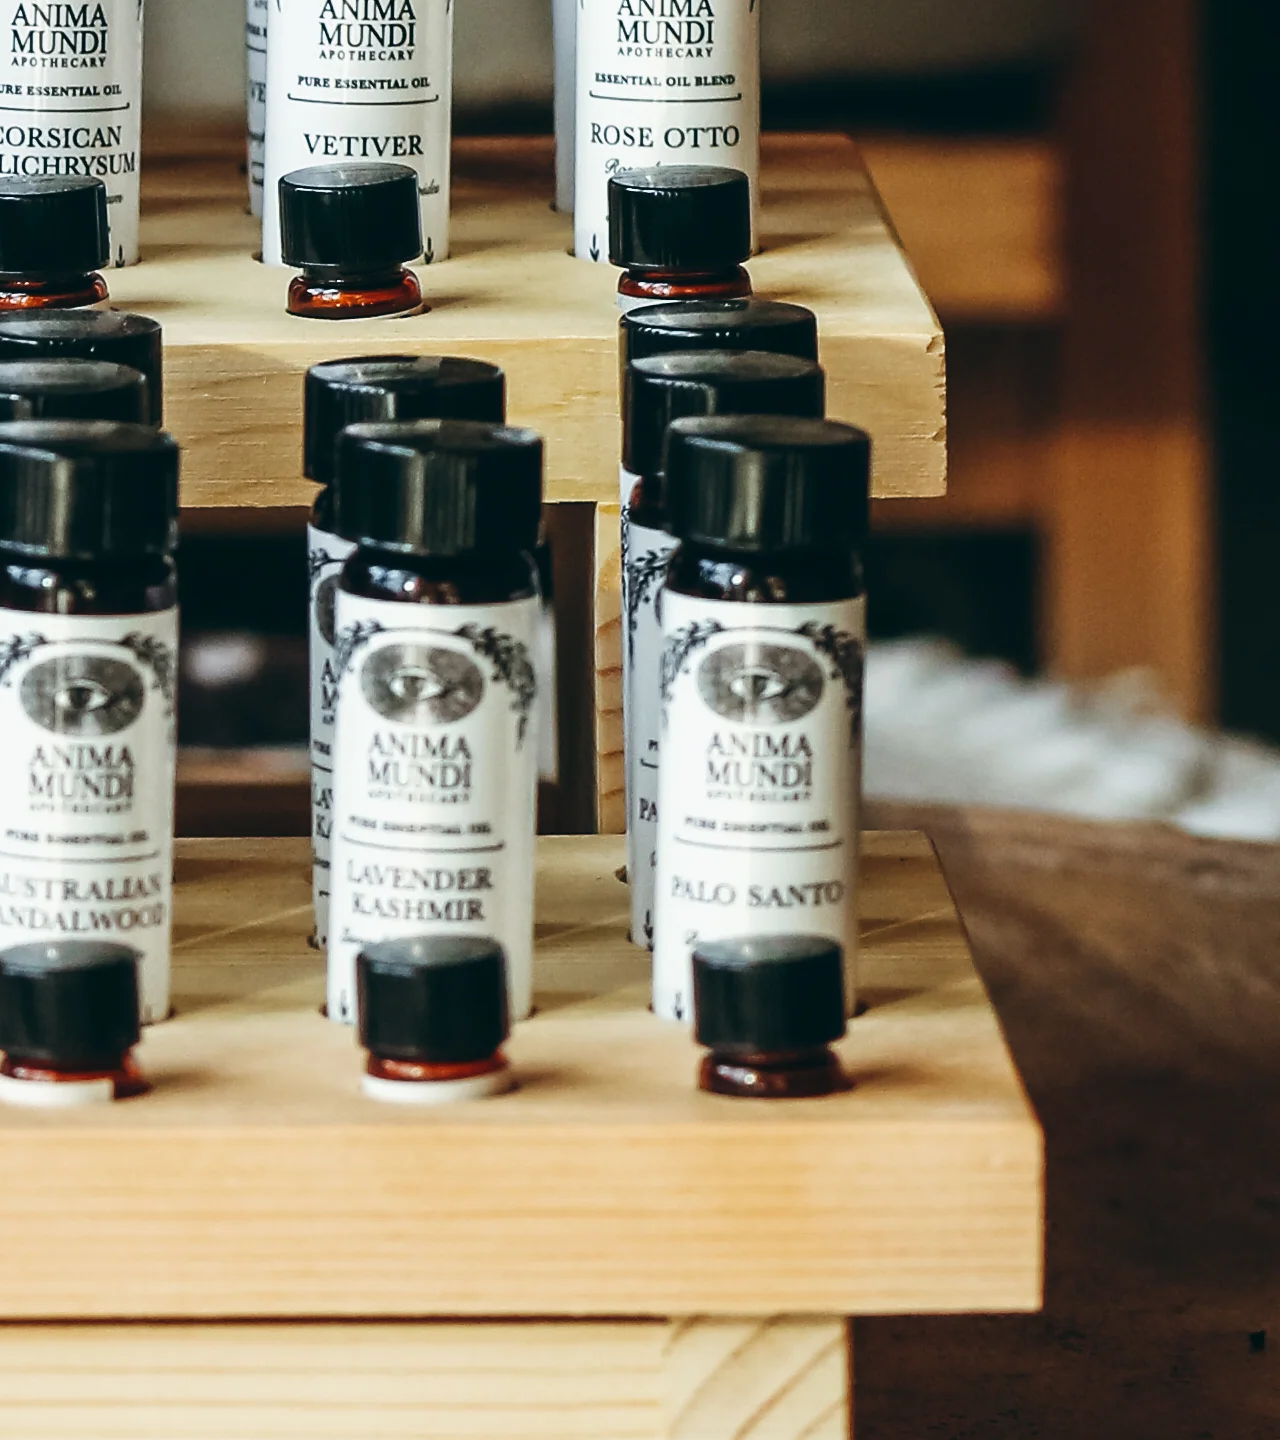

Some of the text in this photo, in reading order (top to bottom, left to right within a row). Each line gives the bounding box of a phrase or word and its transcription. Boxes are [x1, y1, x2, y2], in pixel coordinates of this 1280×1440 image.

[11, 3, 108, 27] ANIMA
[11, 30, 107, 55] MUNDI
[319, 23, 415, 47] MUNDI
[617, 20, 714, 44] MUNDI
[11, 57, 106, 67] APOTHECARY
[319, 50, 414, 60] APOTHECARY
[618, 47, 713, 58] APOTHECARY
[27, 86, 100, 97] ESSENTIAL
[103, 84, 121, 95] OIL
[297, 75, 430, 89] PURE ESSENTIAL OIL
[595, 73, 735, 86] ESSENTIAL OIL BLEND
[303, 134, 424, 156] VETIVER
[591, 122, 740, 148] ROSE OTTO
[30, 744, 136, 770] ANIMA
[369, 732, 472, 760] ANIMA
[706, 732, 812, 757] ANIMA
[29, 771, 133, 800] MUNDI
[368, 760, 471, 789] MUNDI
[706, 760, 812, 788] MUNDI
[347, 859, 493, 891] LAVENDER
[670, 876, 843, 908] PALO SANTO
[352, 893, 485, 921] KASHMIR
